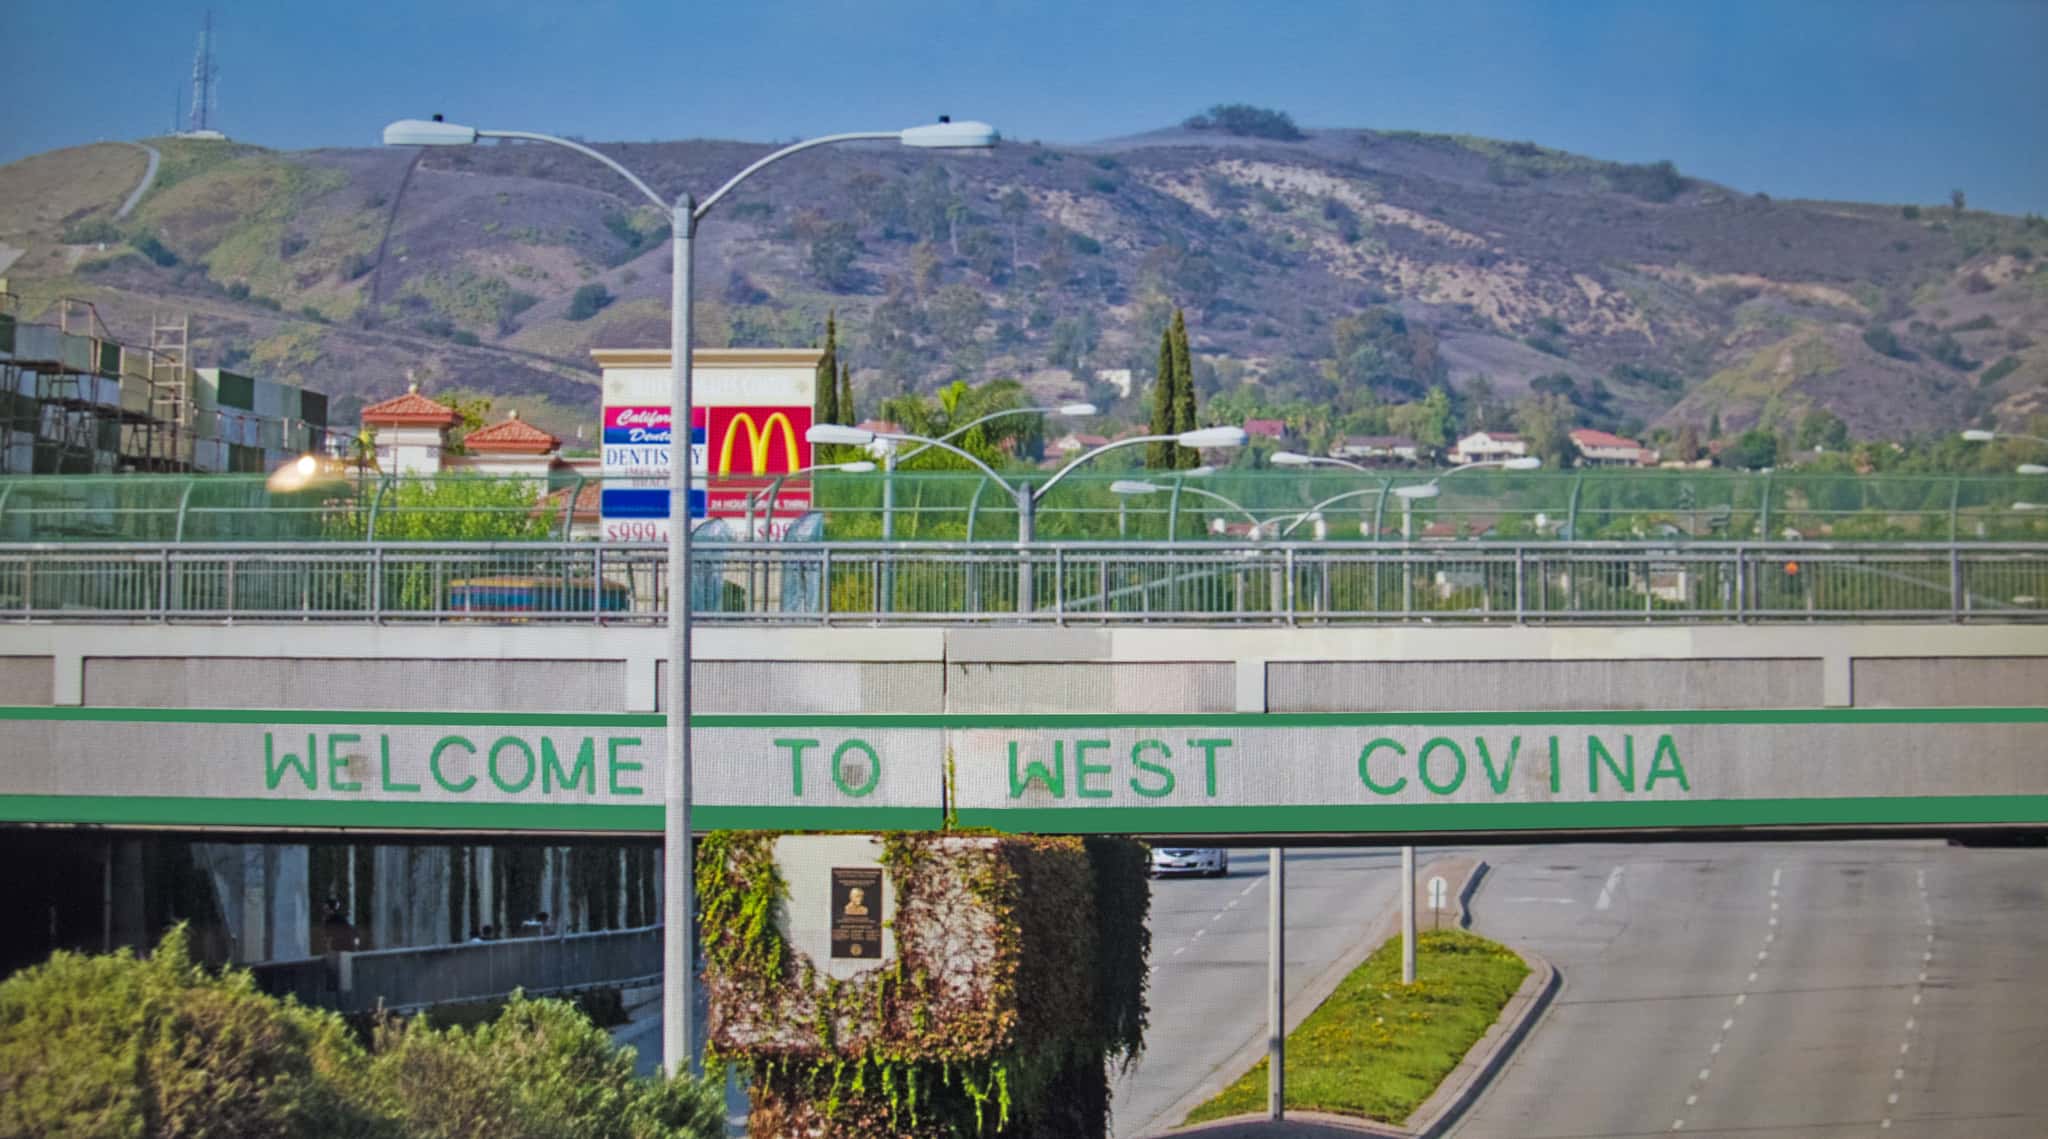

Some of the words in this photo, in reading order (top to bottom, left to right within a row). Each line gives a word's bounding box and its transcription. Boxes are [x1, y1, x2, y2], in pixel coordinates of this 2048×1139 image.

[607, 447, 703, 465] DENTISY
[265, 733, 643, 796] WELCOME
[775, 737, 881, 797] TO
[1008, 737, 1233, 800] WEST
[1358, 733, 1690, 796] COVINA
